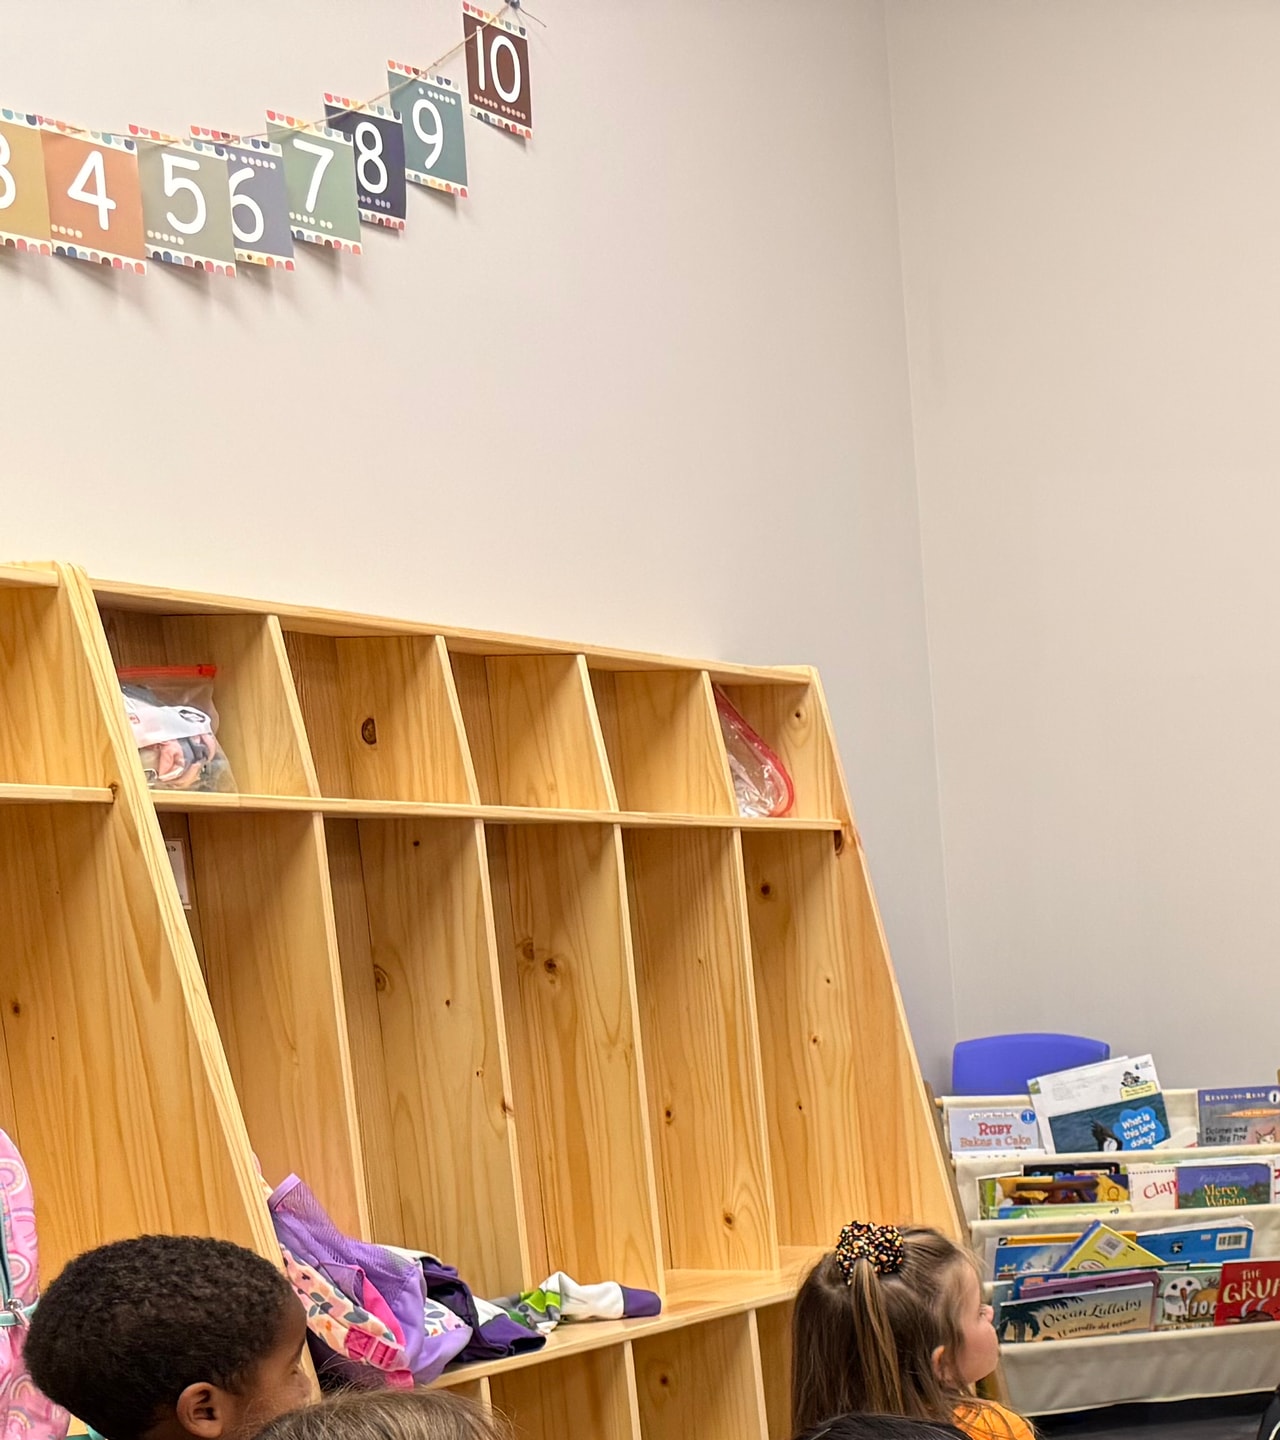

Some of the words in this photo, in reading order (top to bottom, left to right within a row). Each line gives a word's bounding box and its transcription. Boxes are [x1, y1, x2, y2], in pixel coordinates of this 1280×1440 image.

[475, 25, 522, 104] 10
[355, 121, 390, 194] 8
[412, 98, 444, 170] 9
[66, 150, 117, 231] 4
[161, 154, 207, 235] 5
[229, 167, 265, 243] 6
[293, 138, 335, 213] 7
[1121, 1114, 1142, 1130] What
[1142, 1112, 1151, 1122] is
[1123, 1127, 1140, 1140] this
[1140, 1120, 1157, 1135] bird
[1130, 1131, 1157, 1149] doing?
[1240, 1268, 1262, 1281] THE
[1042, 1309, 1088, 1329] Ocean
[1090, 1299, 1142, 1320] Lullaby
